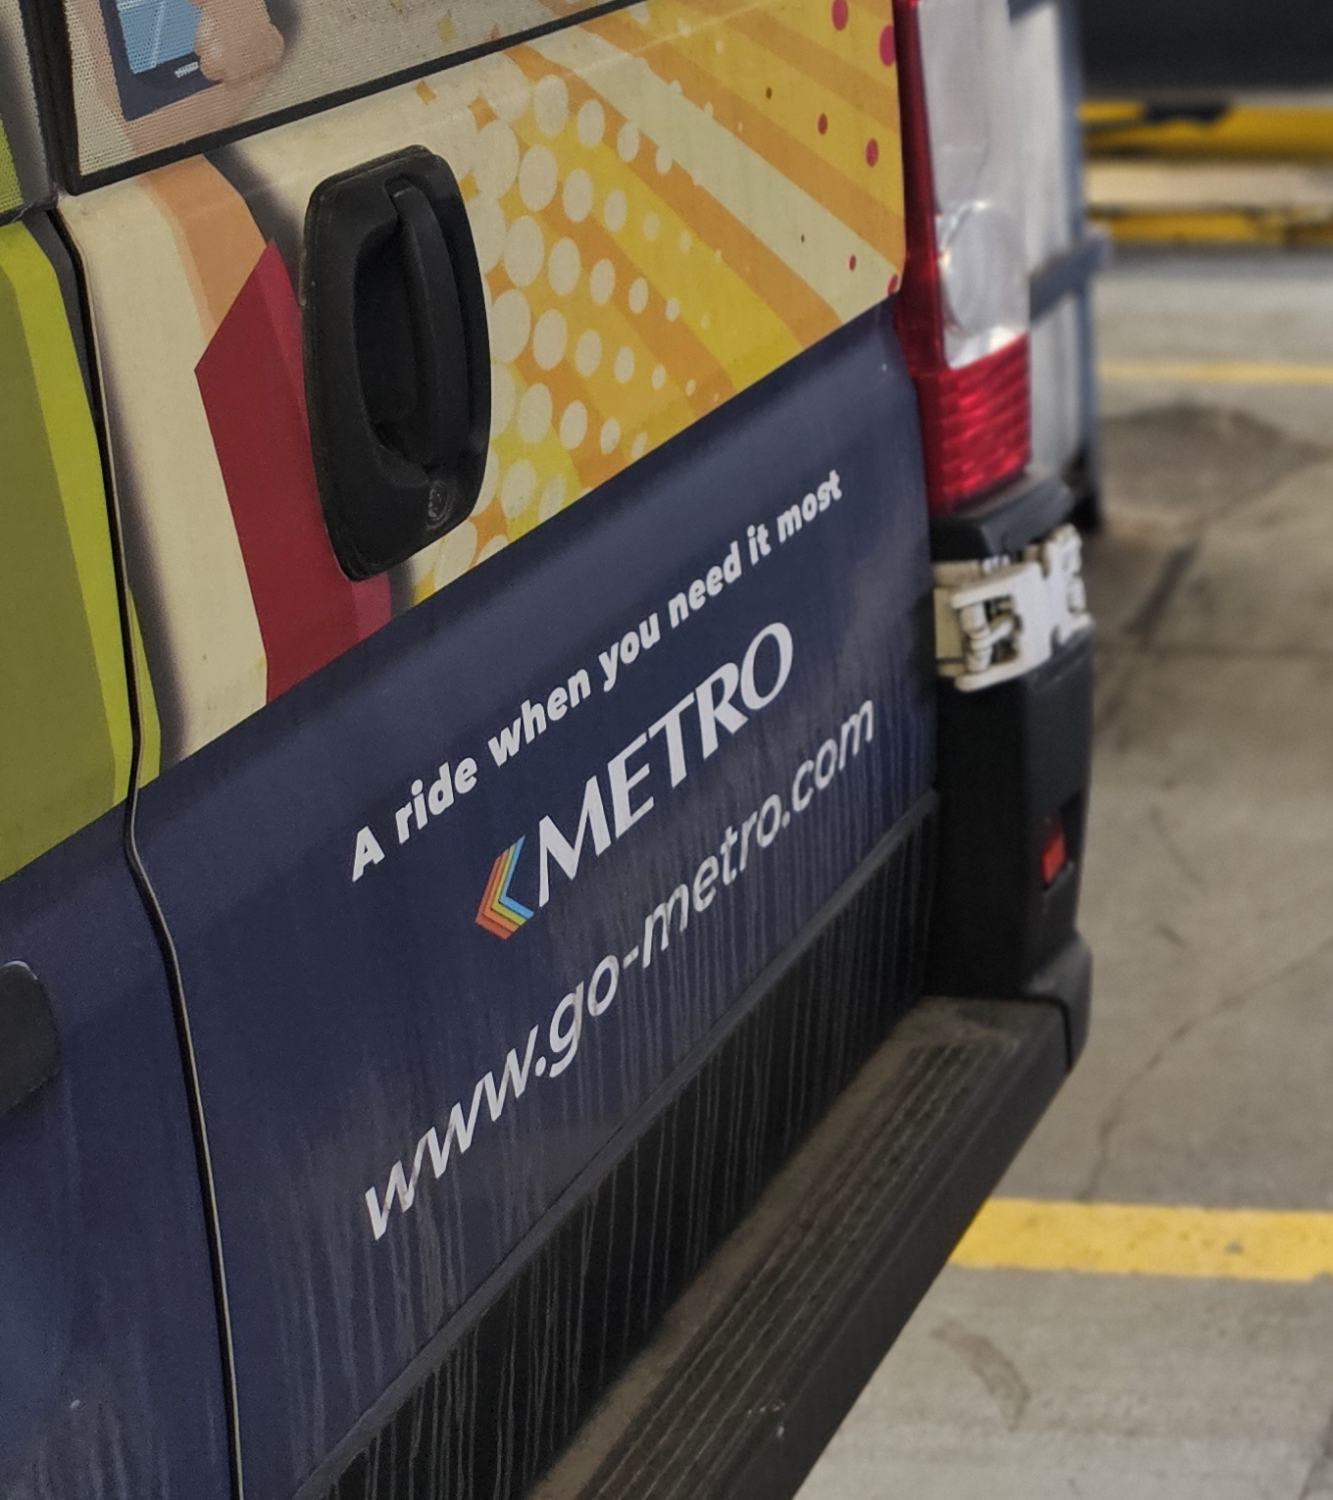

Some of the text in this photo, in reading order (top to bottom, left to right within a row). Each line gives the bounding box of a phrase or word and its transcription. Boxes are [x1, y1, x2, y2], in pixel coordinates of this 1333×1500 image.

[352, 469, 842, 882] A ride when you need it most
[537, 622, 793, 908] METRO
[363, 700, 874, 1241] www.go-metro.com
